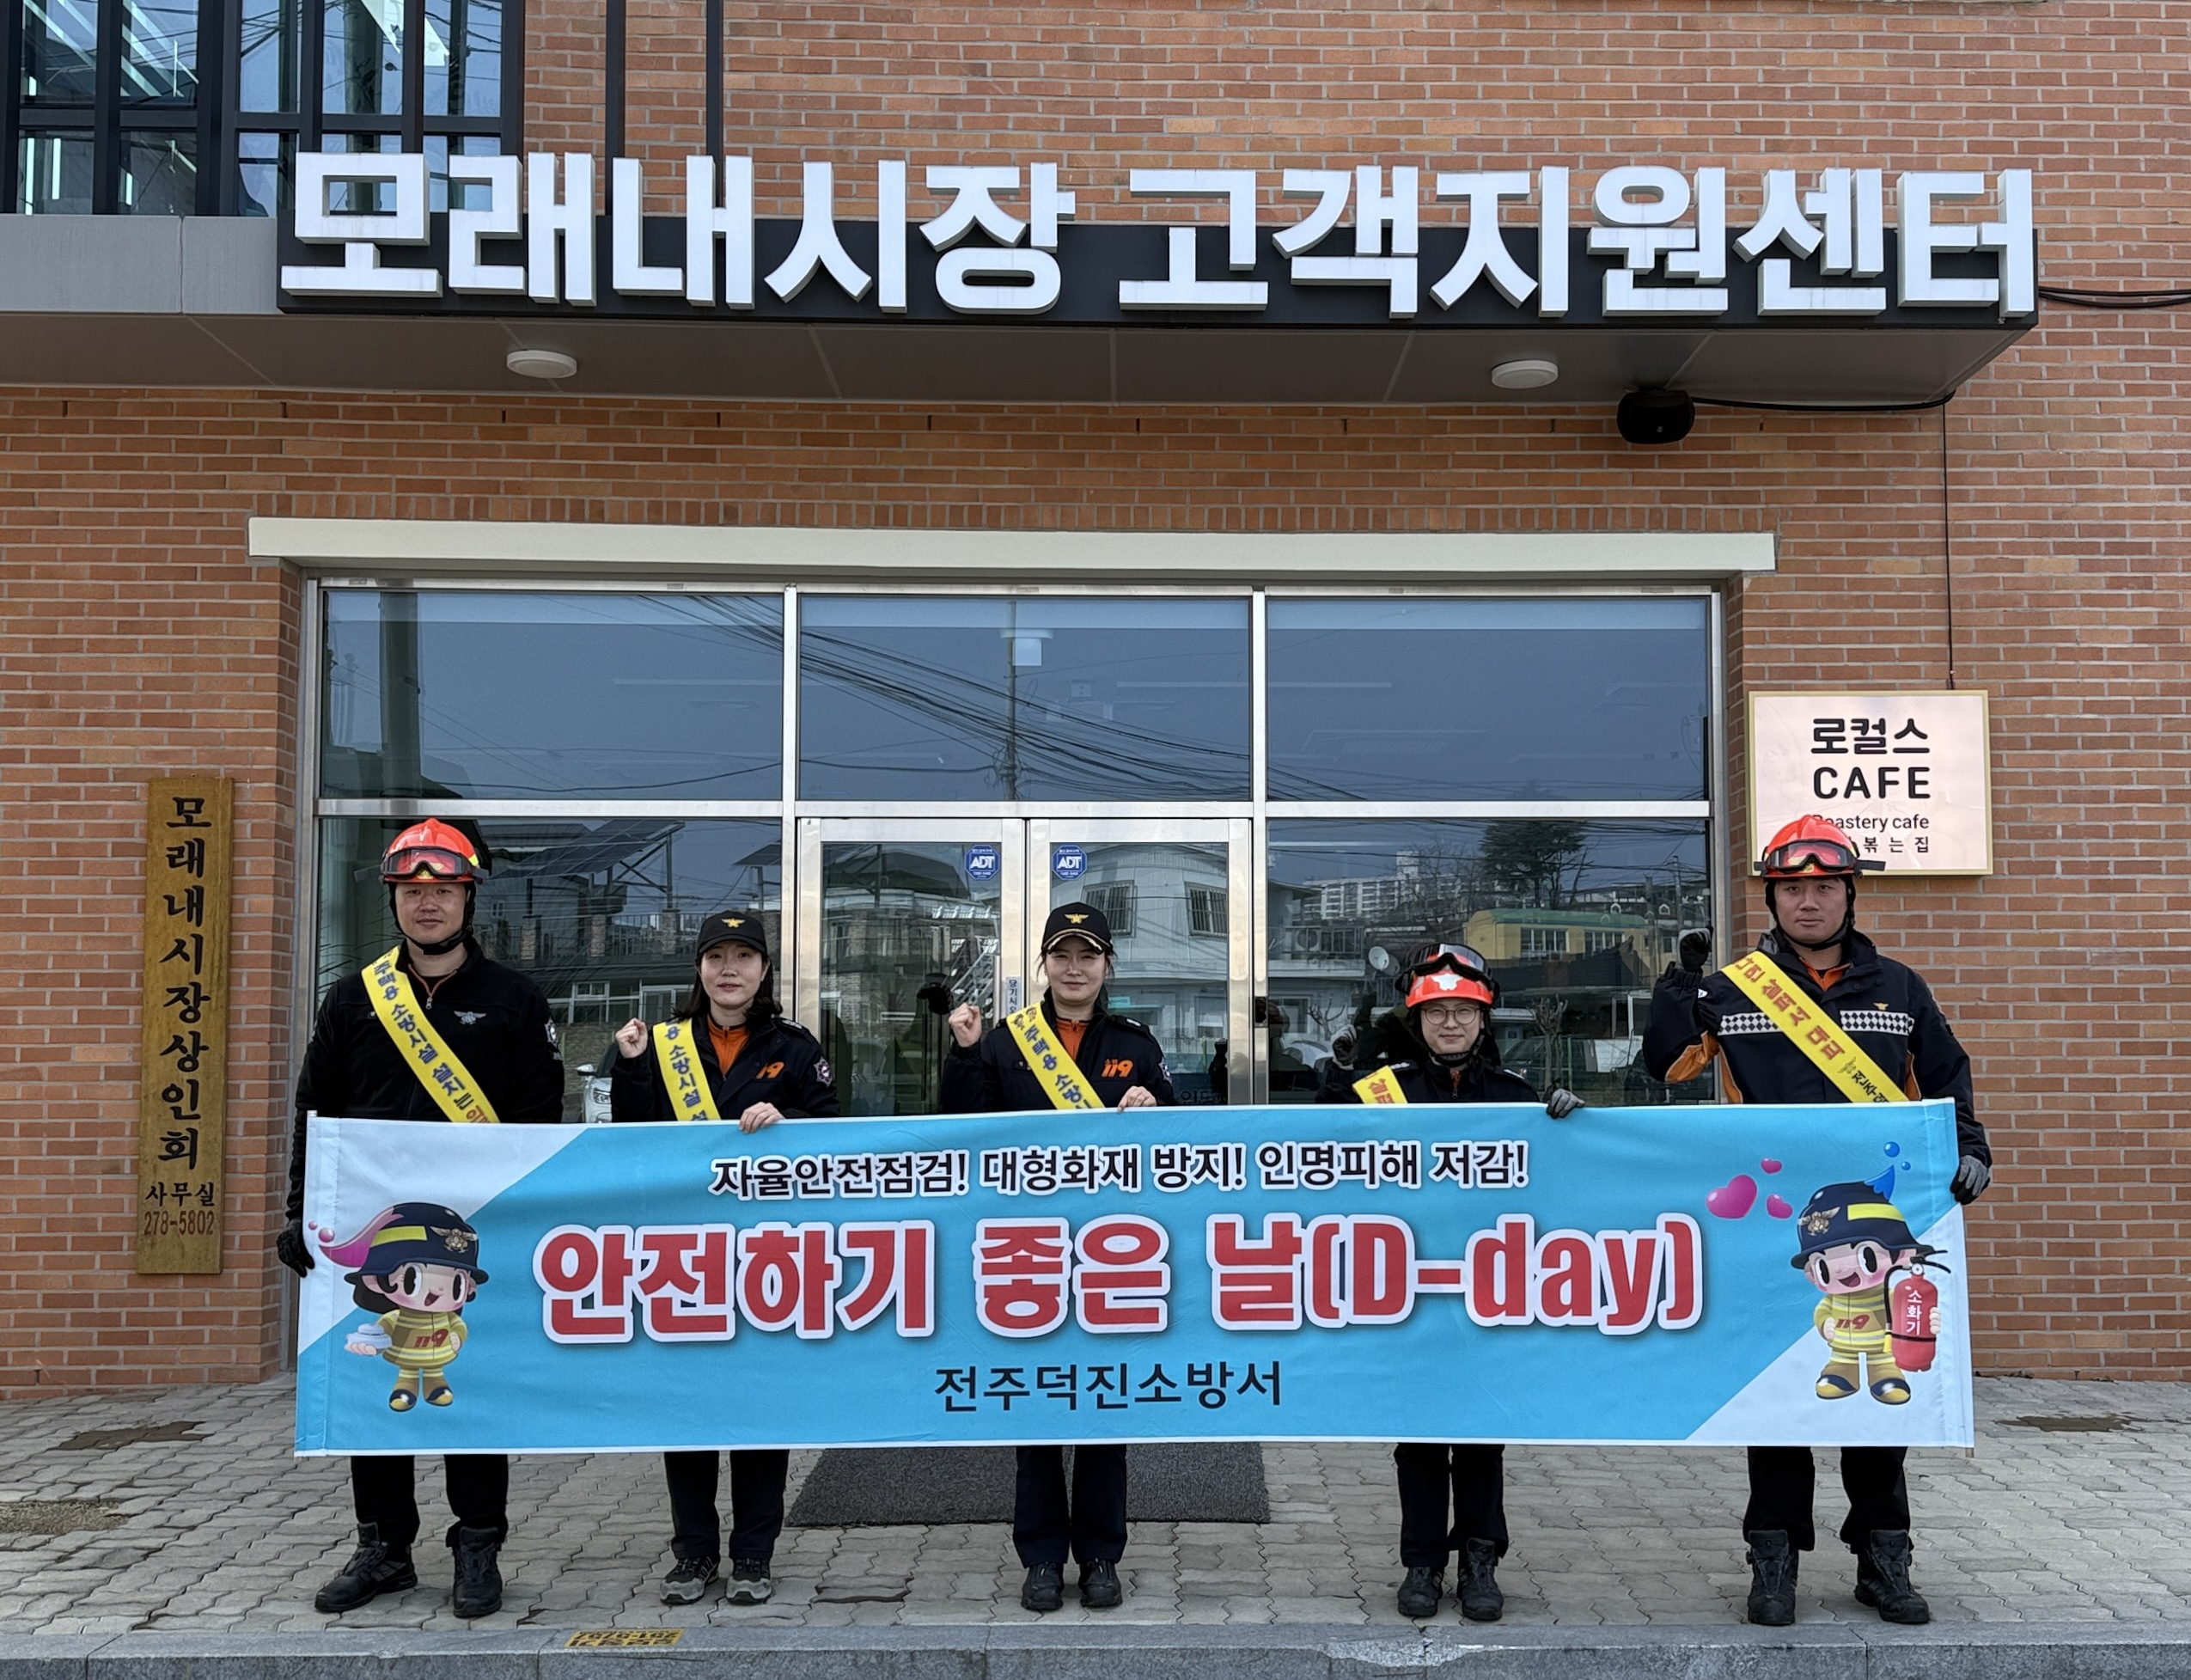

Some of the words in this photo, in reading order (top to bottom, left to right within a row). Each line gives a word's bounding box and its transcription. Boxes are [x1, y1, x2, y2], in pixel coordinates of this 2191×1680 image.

[280, 151, 1076, 315] 모래내시장
[1119, 163, 2034, 319] 고객지원센터
[1810, 718, 1930, 754] 로컬스
[1813, 767, 1931, 799] CAFE
[1813, 815, 1889, 833] astery
[1893, 814, 1929, 829] cafe
[969, 855, 995, 869] ADT
[1057, 855, 1082, 869] ADT
[158, 796, 212, 1170] 모래내시장상인회
[1762, 979, 1811, 1027] 살펴서
[1807, 1025, 1846, 1060] 대피
[391, 1004, 438, 1065] 소방시설
[432, 1062, 474, 1110] 설치는
[1023, 1023, 1058, 1071] 주택용
[1101, 1059, 1133, 1078] 119
[668, 1045, 702, 1109] 소방시설
[144, 1180, 215, 1208] 사무실
[711, 1152, 967, 1198] 자율안전점검!
[983, 1147, 1138, 1192] 대형화재
[1154, 1145, 1243, 1189] 방지!
[1258, 1143, 1419, 1187] 인명피해
[1432, 1143, 1525, 1185] 저감!
[143, 1210, 215, 1237] 278-5802
[542, 1229, 926, 1334] 안전하기
[981, 1222, 1163, 1328] 좋은
[1214, 1222, 1694, 1325] 날(D-day)
[1906, 1290, 1923, 1336] 소화기
[934, 1360, 1281, 1413] 전주덕진소방서
